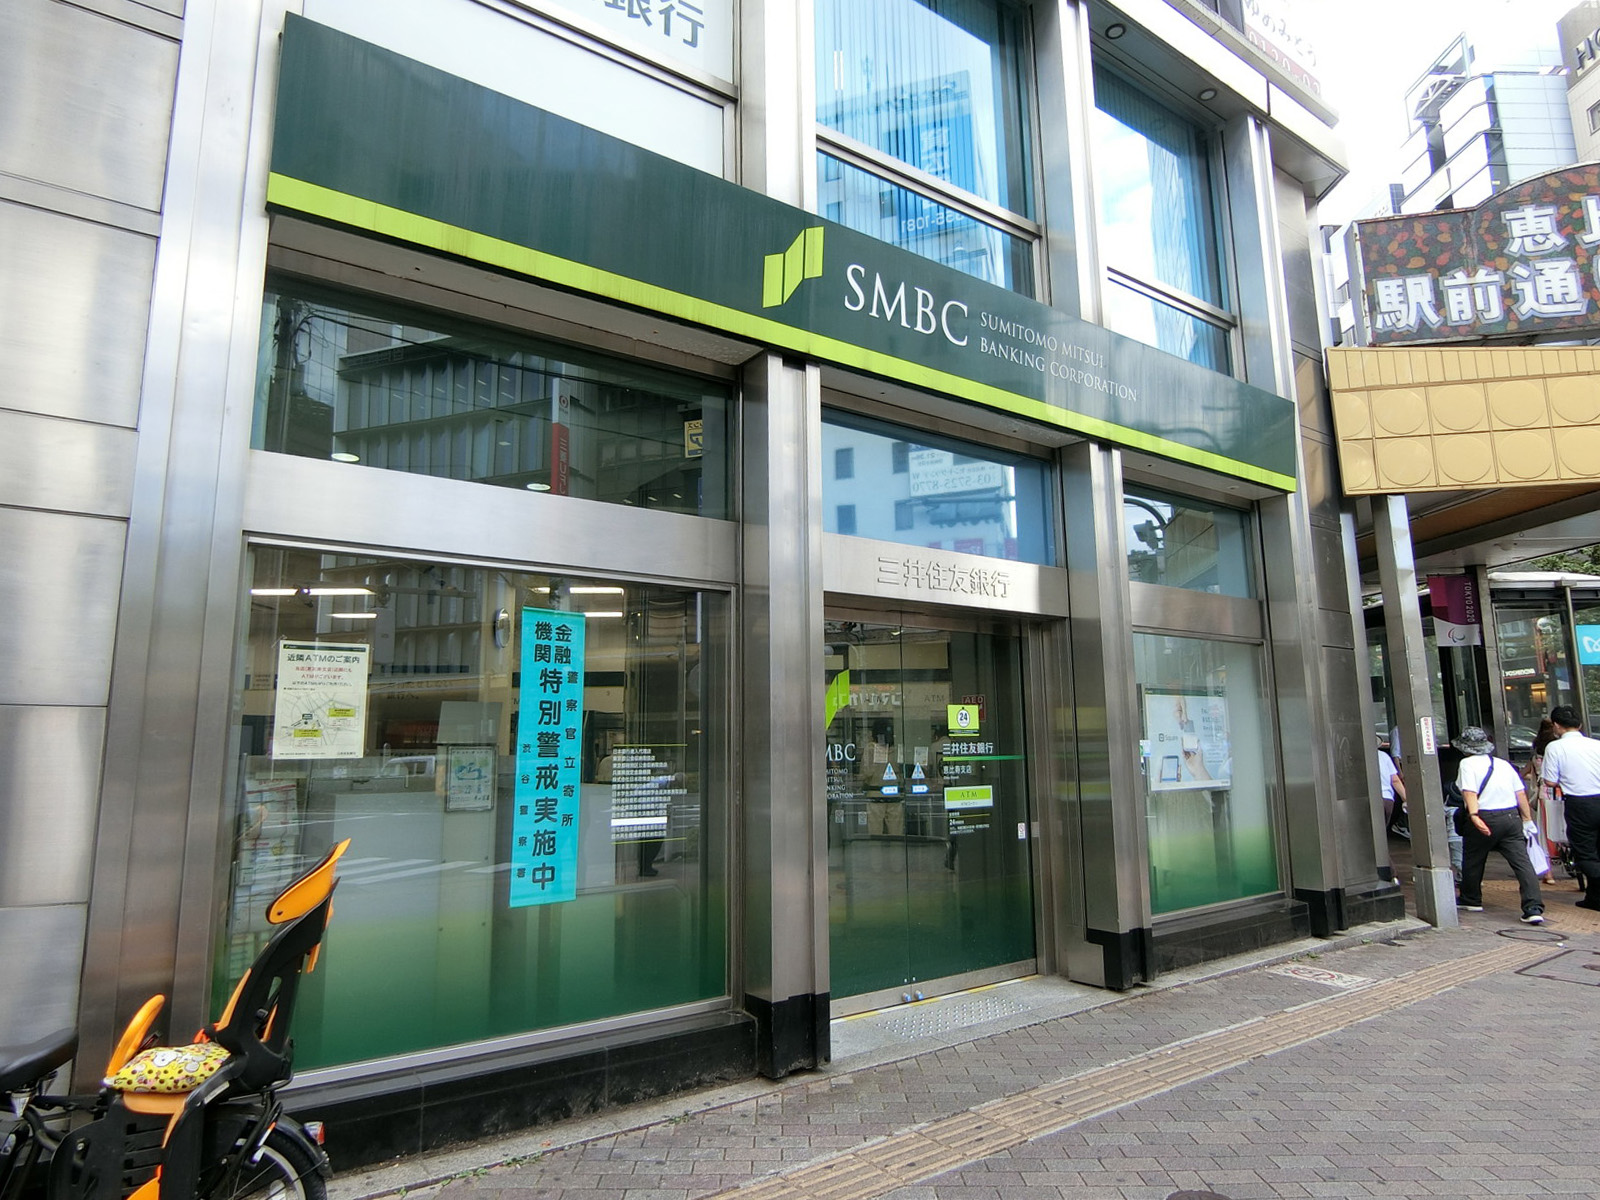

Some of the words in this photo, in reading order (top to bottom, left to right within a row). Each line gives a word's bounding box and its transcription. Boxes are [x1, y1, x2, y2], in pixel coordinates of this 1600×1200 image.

[844, 264, 968, 346] SMBC
[1375, 260, 1600, 330] 駅前通
[980, 312, 1058, 352] SUMITOMO
[1061, 341, 1104, 368] MITSUI
[980, 337, 1045, 372] BANKING
[1050, 361, 1137, 402] CORPORATION
[877, 556, 1010, 598] 三井住友銀行
[287, 653, 360, 664] 近隣ATMのご案内
[534, 621, 553, 663] 機関
[554, 624, 572, 664] 金融
[959, 712, 969, 722] 24
[561, 671, 578, 826] 警察官立寄所
[825, 743, 856, 761] MBC
[943, 742, 994, 755] 三井住友銀行
[532, 668, 563, 891] 特別警戒実施中
[516, 743, 531, 878] 渋谷警察署
